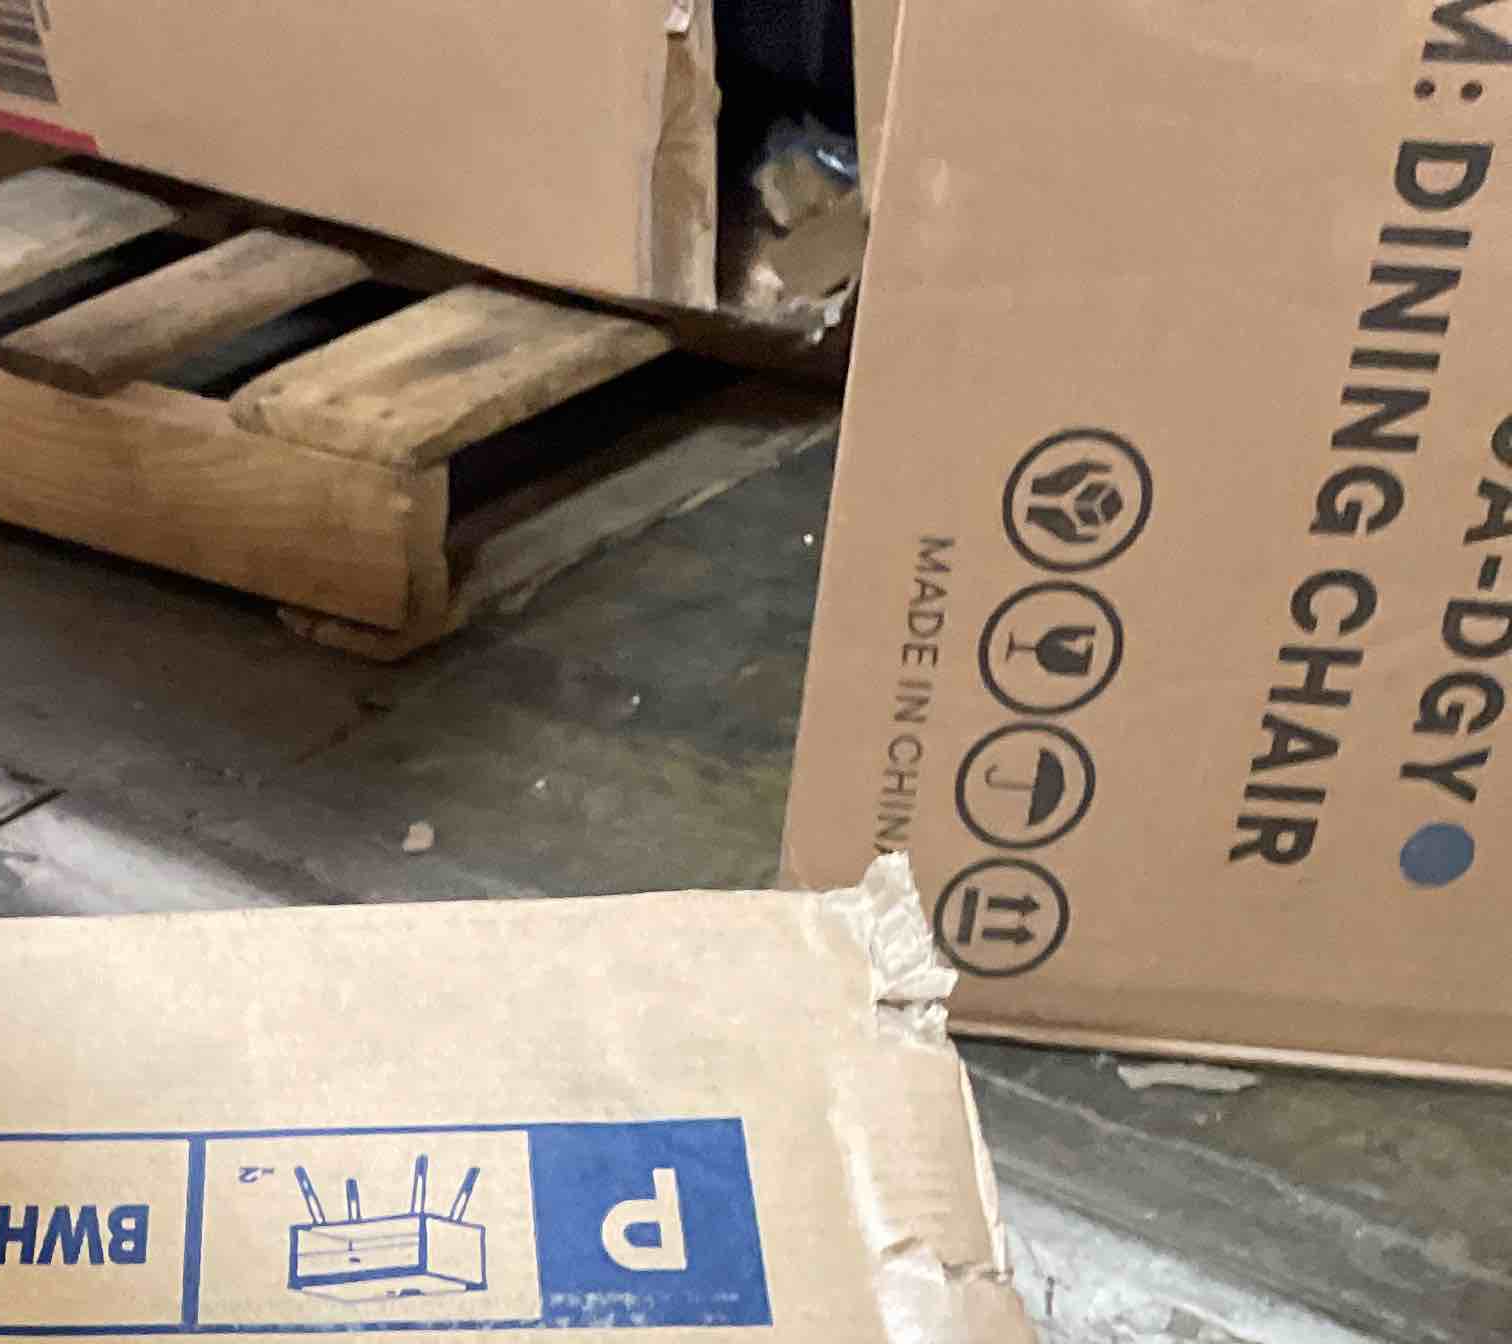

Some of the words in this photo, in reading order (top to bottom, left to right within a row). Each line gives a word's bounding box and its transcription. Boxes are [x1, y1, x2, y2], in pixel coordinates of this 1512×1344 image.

[1309, 139, 1493, 536] DINING
[893, 679, 932, 724] IN
[901, 536, 955, 667] MADE
[1400, 411, 1512, 803] A-DGY
[1229, 569, 1378, 865] CHAIR
[601, 1167, 688, 1272] P
